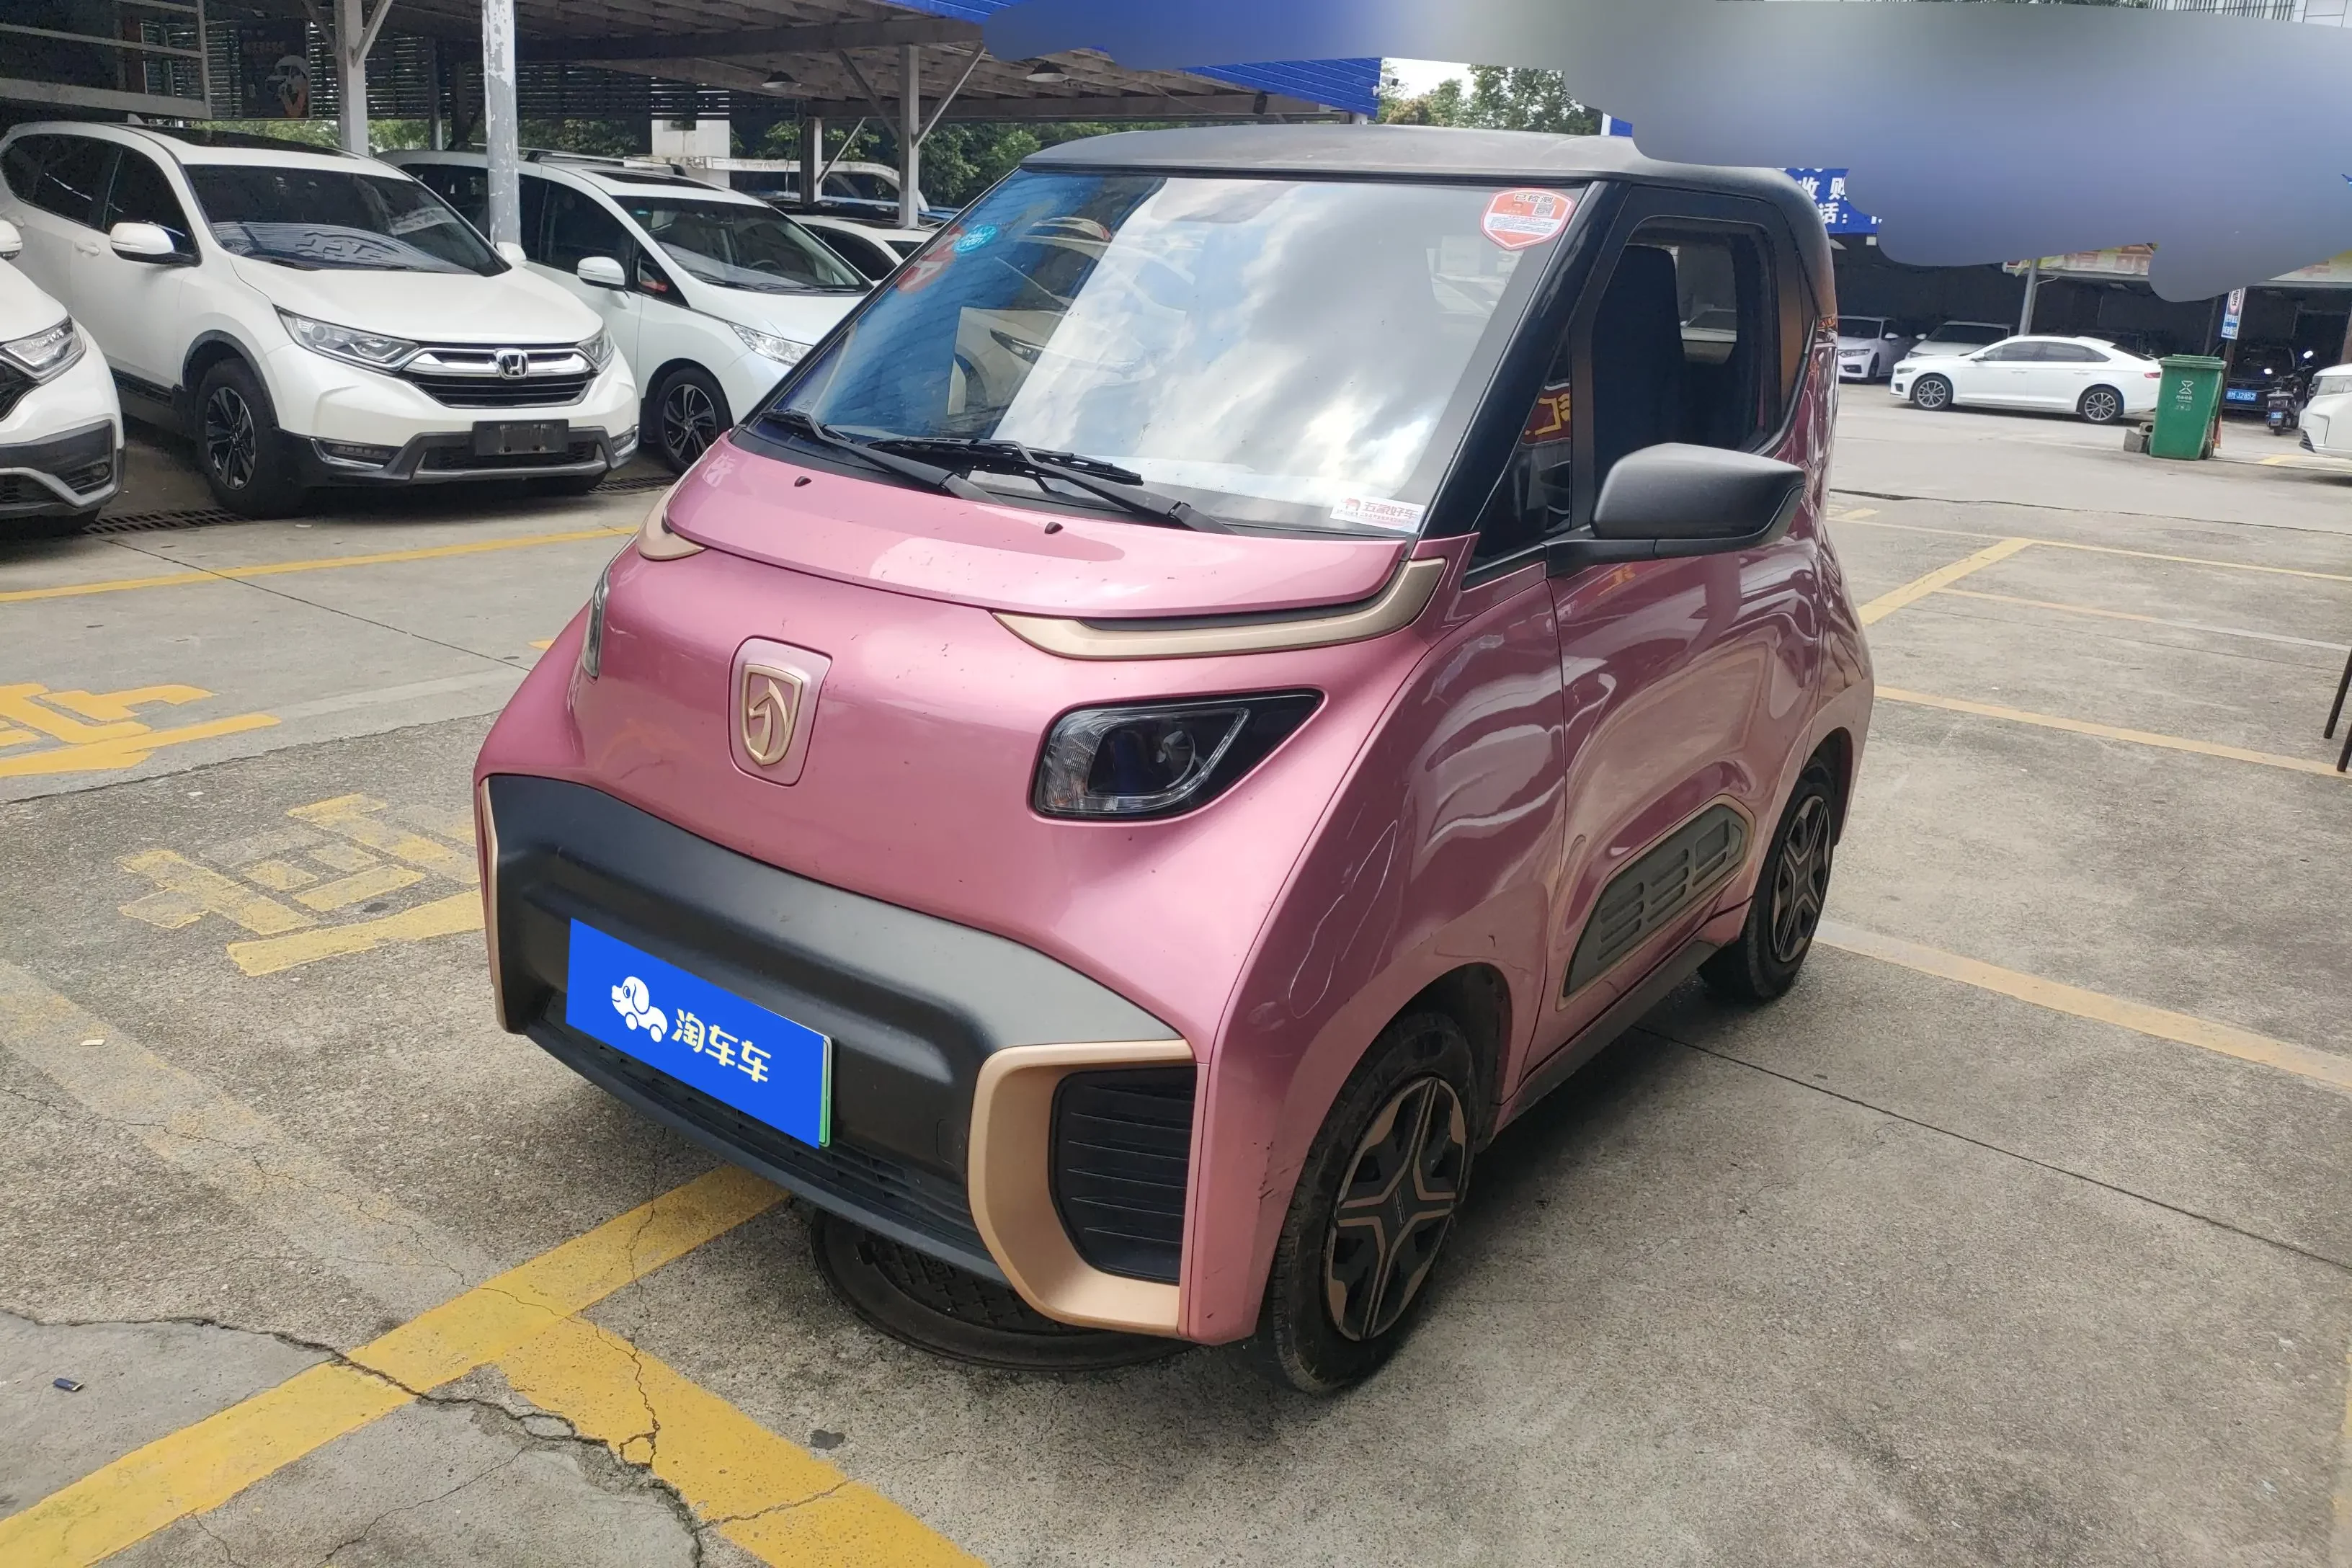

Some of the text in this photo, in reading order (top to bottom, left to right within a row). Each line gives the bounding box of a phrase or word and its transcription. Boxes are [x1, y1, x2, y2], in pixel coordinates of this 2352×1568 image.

[1515, 193, 1554, 204] 已检测
[1362, 501, 1419, 520] 五象好车
